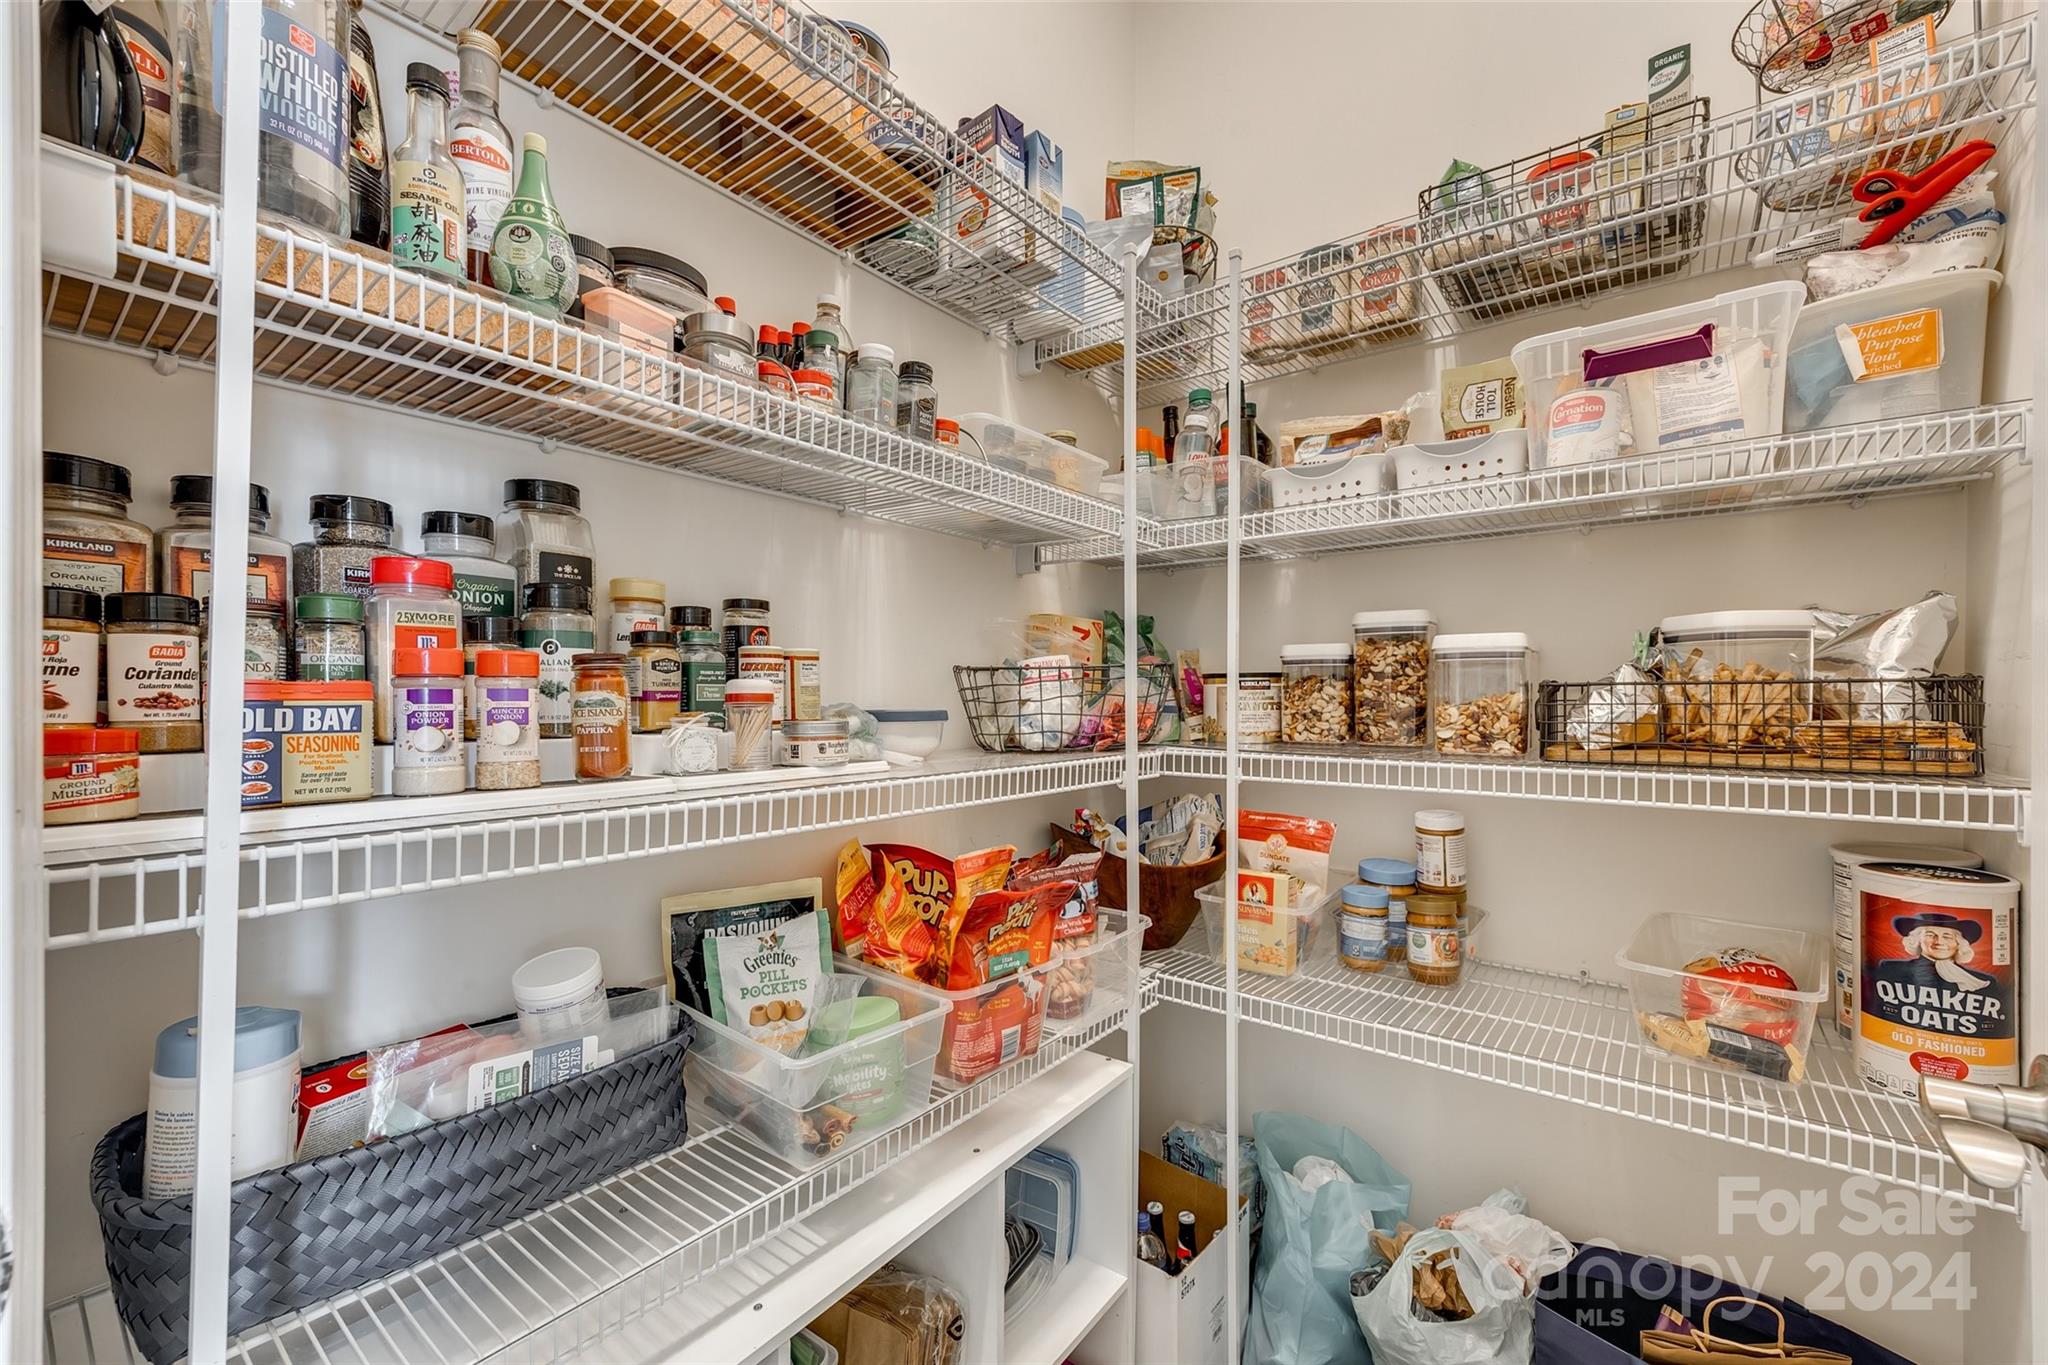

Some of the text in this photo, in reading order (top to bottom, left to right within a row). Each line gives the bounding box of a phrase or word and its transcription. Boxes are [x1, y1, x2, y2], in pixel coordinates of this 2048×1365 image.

[1654, 51, 1685, 68] ORGANIC
[260, 36, 338, 102] DISTILLED
[260, 62, 338, 129] WHITE
[451, 143, 508, 169] BERTOLLI
[400, 191, 460, 215] SESAME OIL
[411, 201, 439, 262] 胡麻油
[1864, 334, 1924, 352] Purpose
[1475, 385, 1485, 419] HOUSE
[1486, 388, 1497, 413] TOLL
[1553, 403, 1604, 423] Carnation
[46, 539, 114, 552] KIRKLAND
[50, 571, 107, 582] ORGANIC
[346, 569, 371, 578] KIRK
[456, 578, 498, 591] Organic
[449, 590, 504, 605] ONION
[463, 604, 492, 612] Chopped
[415, 613, 455, 622] MORE
[151, 647, 184, 657] BADIA
[310, 655, 361, 664] ORGANIC
[320, 665, 354, 673] FENNEL
[540, 658, 570, 666] ALIAN
[242, 708, 294, 732] OLD
[587, 707, 623, 717] ISLANDS
[287, 735, 360, 754] SEASONING
[52, 784, 113, 800] Mustard
[59, 779, 106, 789] GROUND
[1259, 851, 1290, 863] SUNDATE
[743, 950, 799, 973] Greenies
[759, 969, 789, 983] PILL
[1725, 965, 1778, 978] PLAIN
[740, 979, 807, 1000] POCKETS
[1876, 980, 2001, 1020] QUAKER
[1901, 1005, 1977, 1034] OATS
[1892, 1031, 1986, 1057] OLD FASHIONED
[558, 1050, 570, 1083] SEPAR
[571, 1046, 581, 1075] SIZE 4
